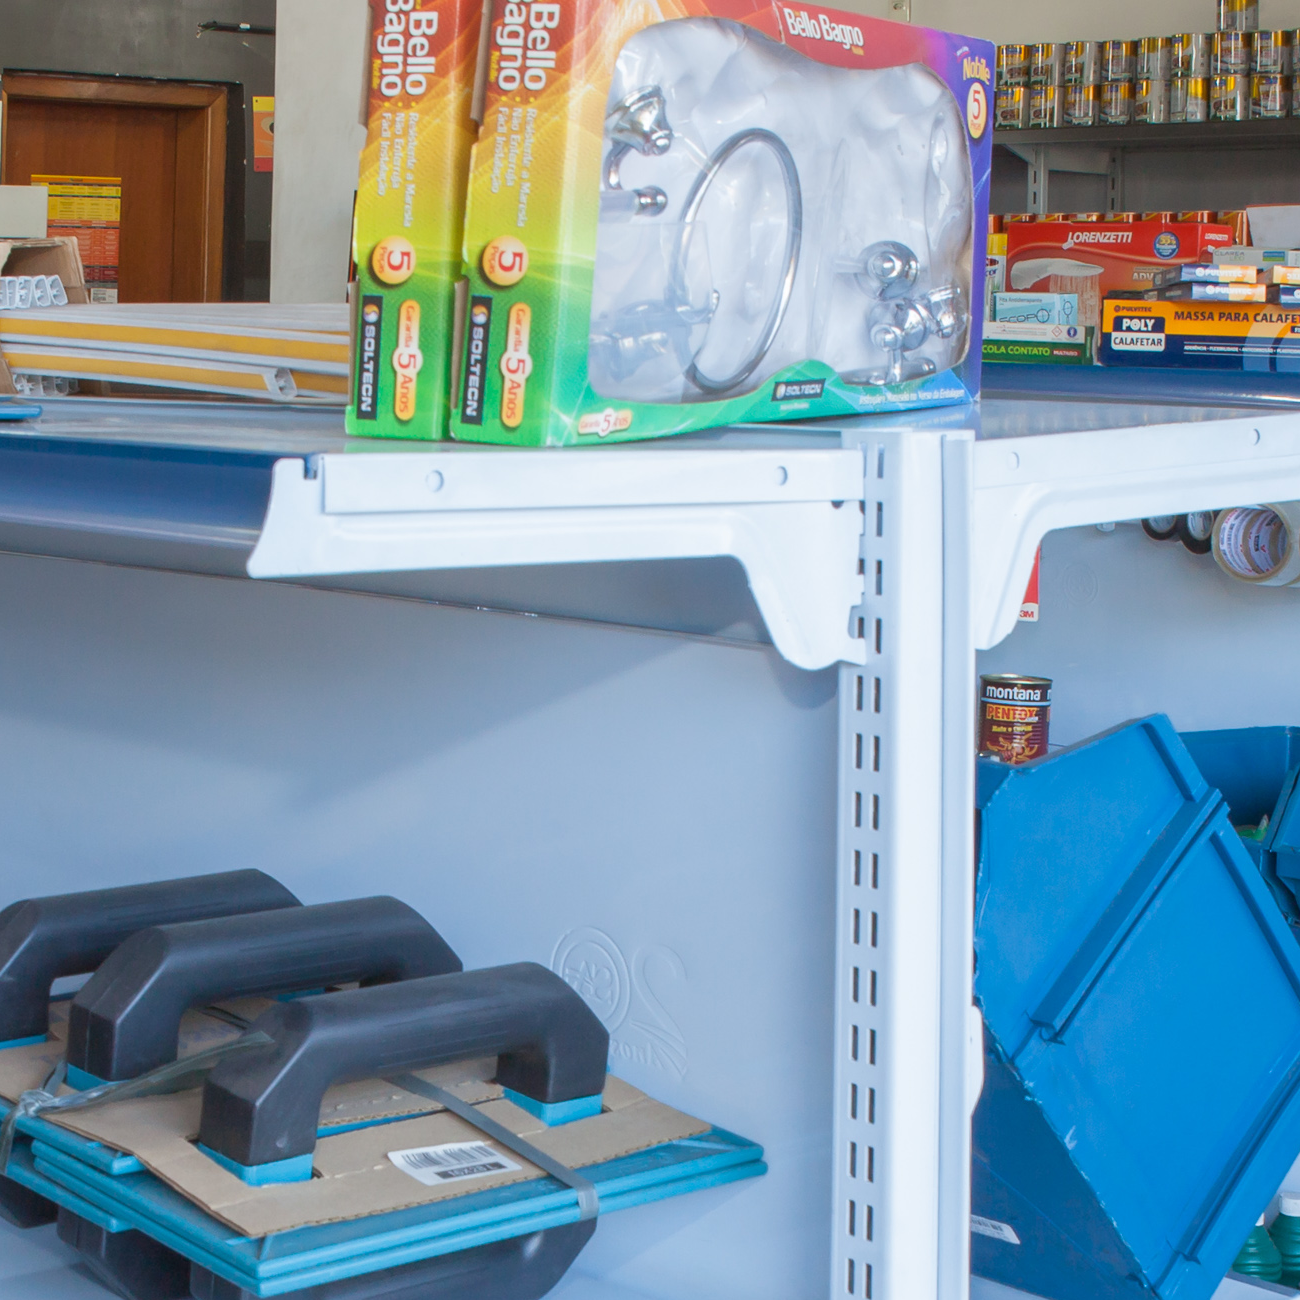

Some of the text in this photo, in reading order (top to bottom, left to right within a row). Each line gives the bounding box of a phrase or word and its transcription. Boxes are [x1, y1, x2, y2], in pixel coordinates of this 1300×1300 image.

[783, 8, 864, 49] Bello Bagno
[405, 11, 439, 95] Bello
[524, 3, 560, 90] Bello
[963, 57, 991, 85] Nobile
[972, 89, 980, 120] 5
[404, 113, 419, 228] Resistente a Maresia
[517, 108, 537, 227] Resistente a Maresia
[1067, 231, 1132, 245] LORENZETTI
[387, 251, 411, 271] 5
[498, 251, 523, 272] 5
[1205, 269, 1242, 278] PULVITEC
[1215, 286, 1251, 295] PULVITEC
[1122, 319, 1155, 331] POLY
[1174, 311, 1214, 322] MASSA
[1218, 312, 1249, 322] PARA
[982, 345, 1006, 353] COLA
[1008, 346, 1050, 355] CONTATO
[1113, 336, 1163, 347] CALAFETAR
[361, 325, 376, 412] SOLTECN
[398, 306, 416, 413] Garantia 5 Anos
[506, 309, 525, 419] Garantia 5 Anos
[466, 327, 484, 416] SOLTECN
[786, 383, 822, 397] SOLTECN
[601, 415, 612, 433] 5
[1020, 610, 1034, 618] 3M
[986, 686, 1040, 701] montana
[987, 704, 1036, 721] PENTOX
